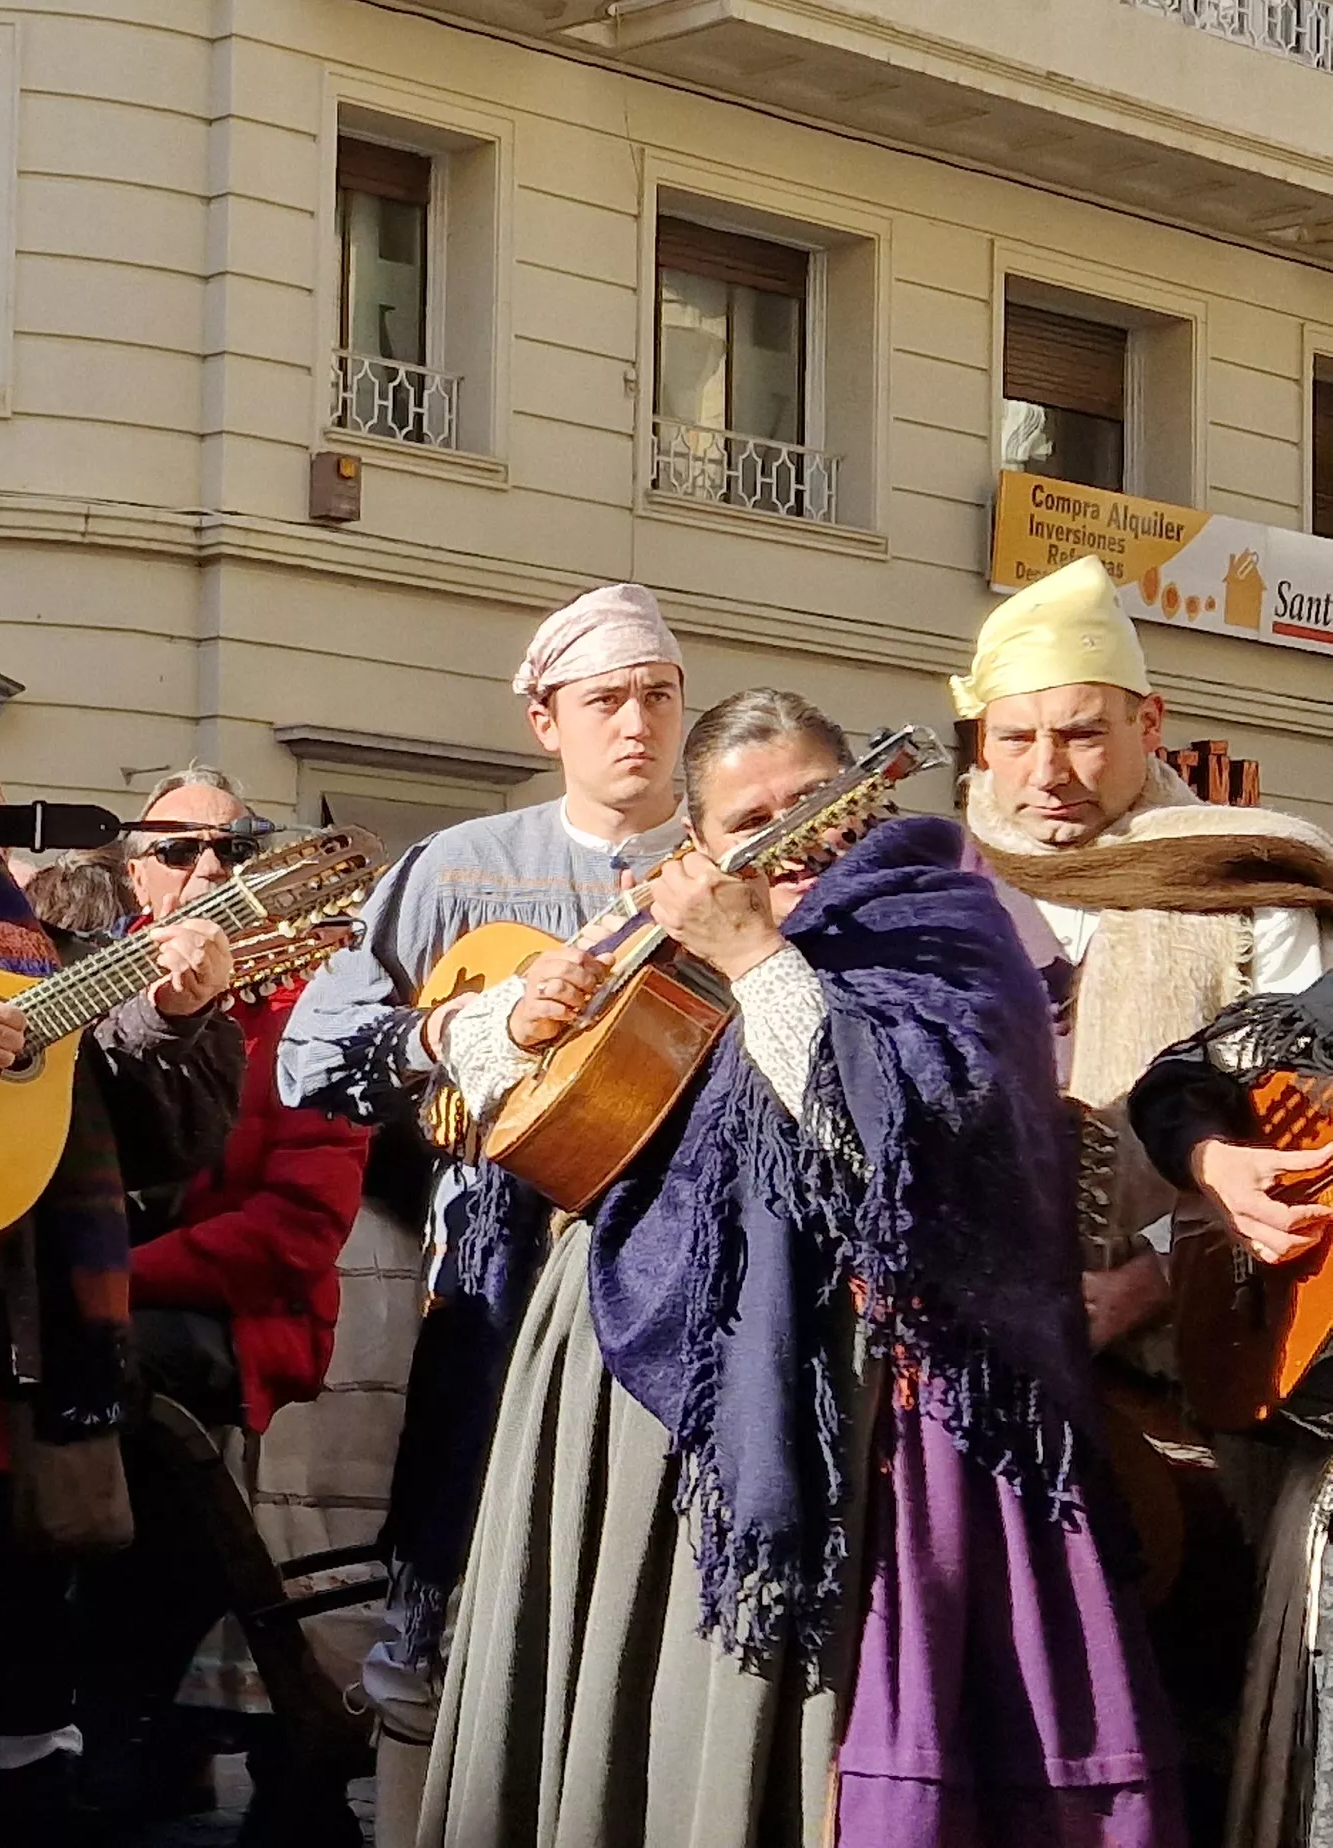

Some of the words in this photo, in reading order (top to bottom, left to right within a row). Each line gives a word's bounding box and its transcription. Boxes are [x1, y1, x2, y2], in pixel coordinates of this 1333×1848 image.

[1029, 514, 1125, 554] Inversiones
[1031, 484, 1100, 521] Compra
[1107, 502, 1185, 543] Alquiler
